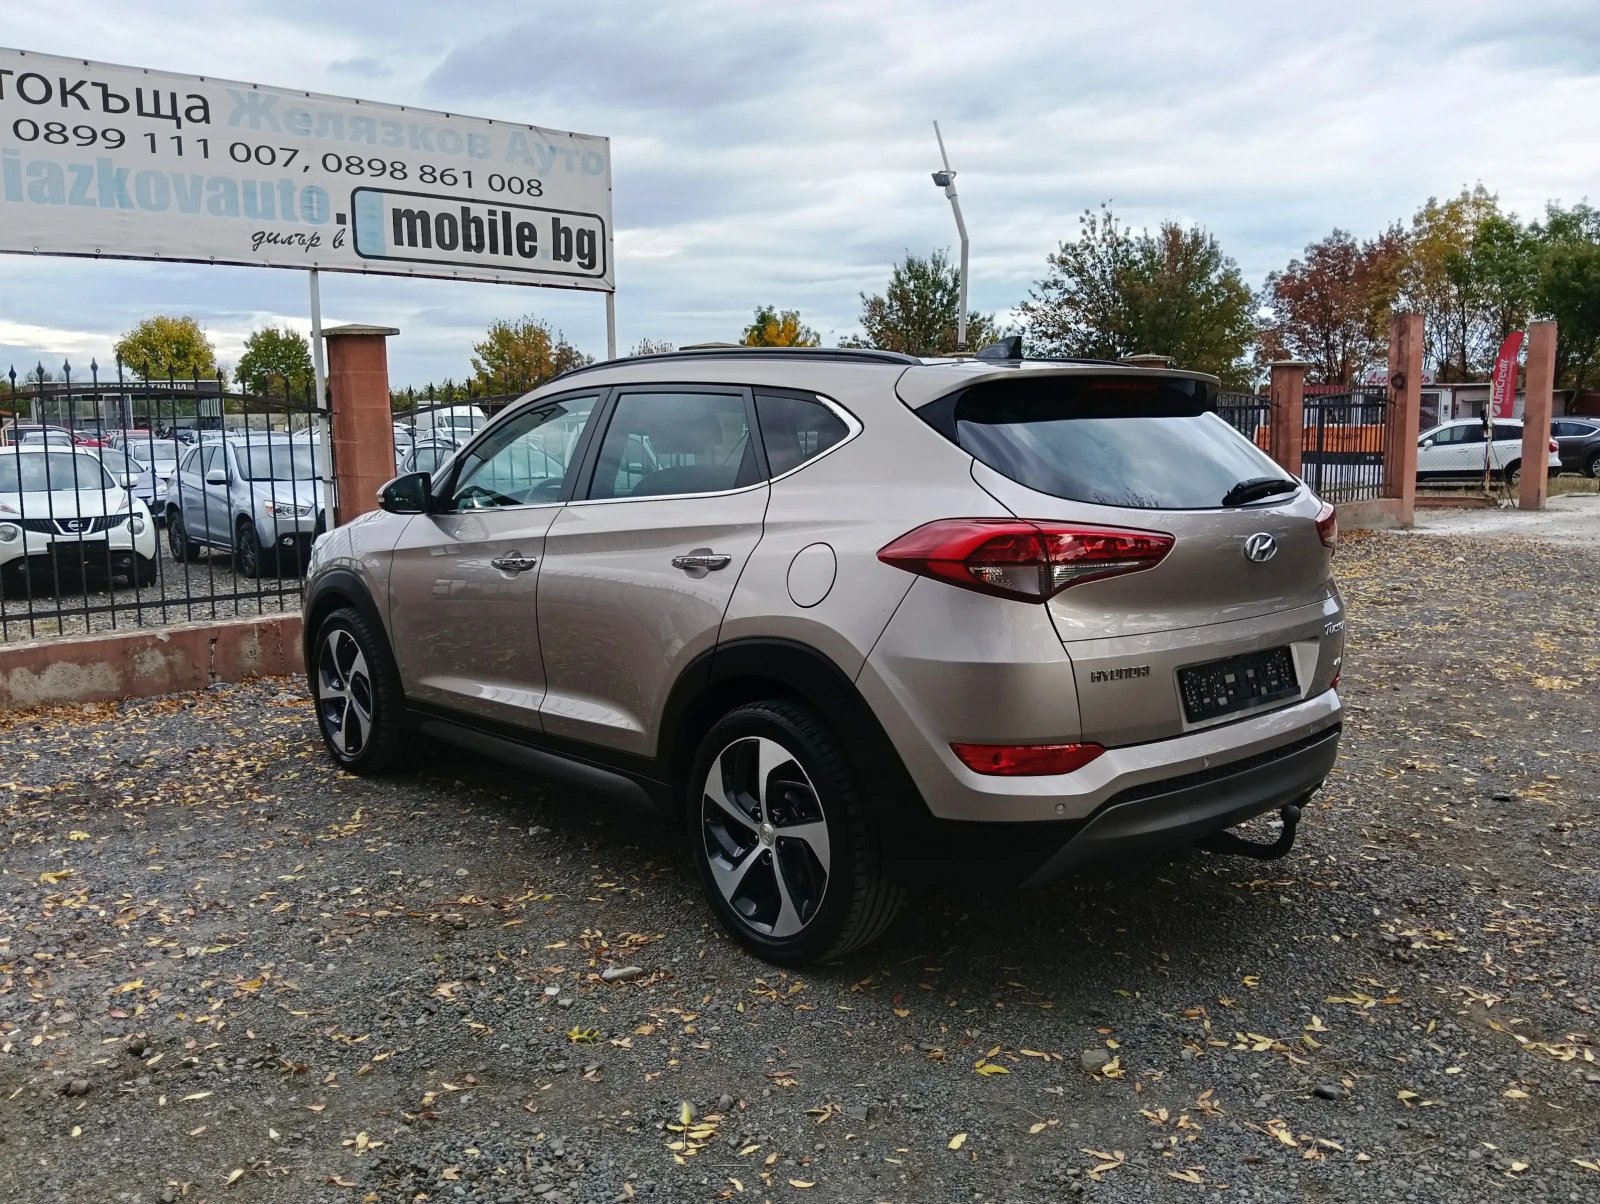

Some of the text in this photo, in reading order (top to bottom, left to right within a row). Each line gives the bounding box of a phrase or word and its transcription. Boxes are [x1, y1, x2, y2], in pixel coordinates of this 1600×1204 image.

[12, 118, 544, 197] 0899 111 007, 0898 861 008
[225, 88, 492, 160] Желязков
[505, 130, 605, 178] Ауто
[251, 227, 346, 254] дилър в
[391, 205, 597, 271] mobile.bg
[1493, 358, 1508, 405] UniCredit
[1090, 664, 1151, 683] HYUNDAI
